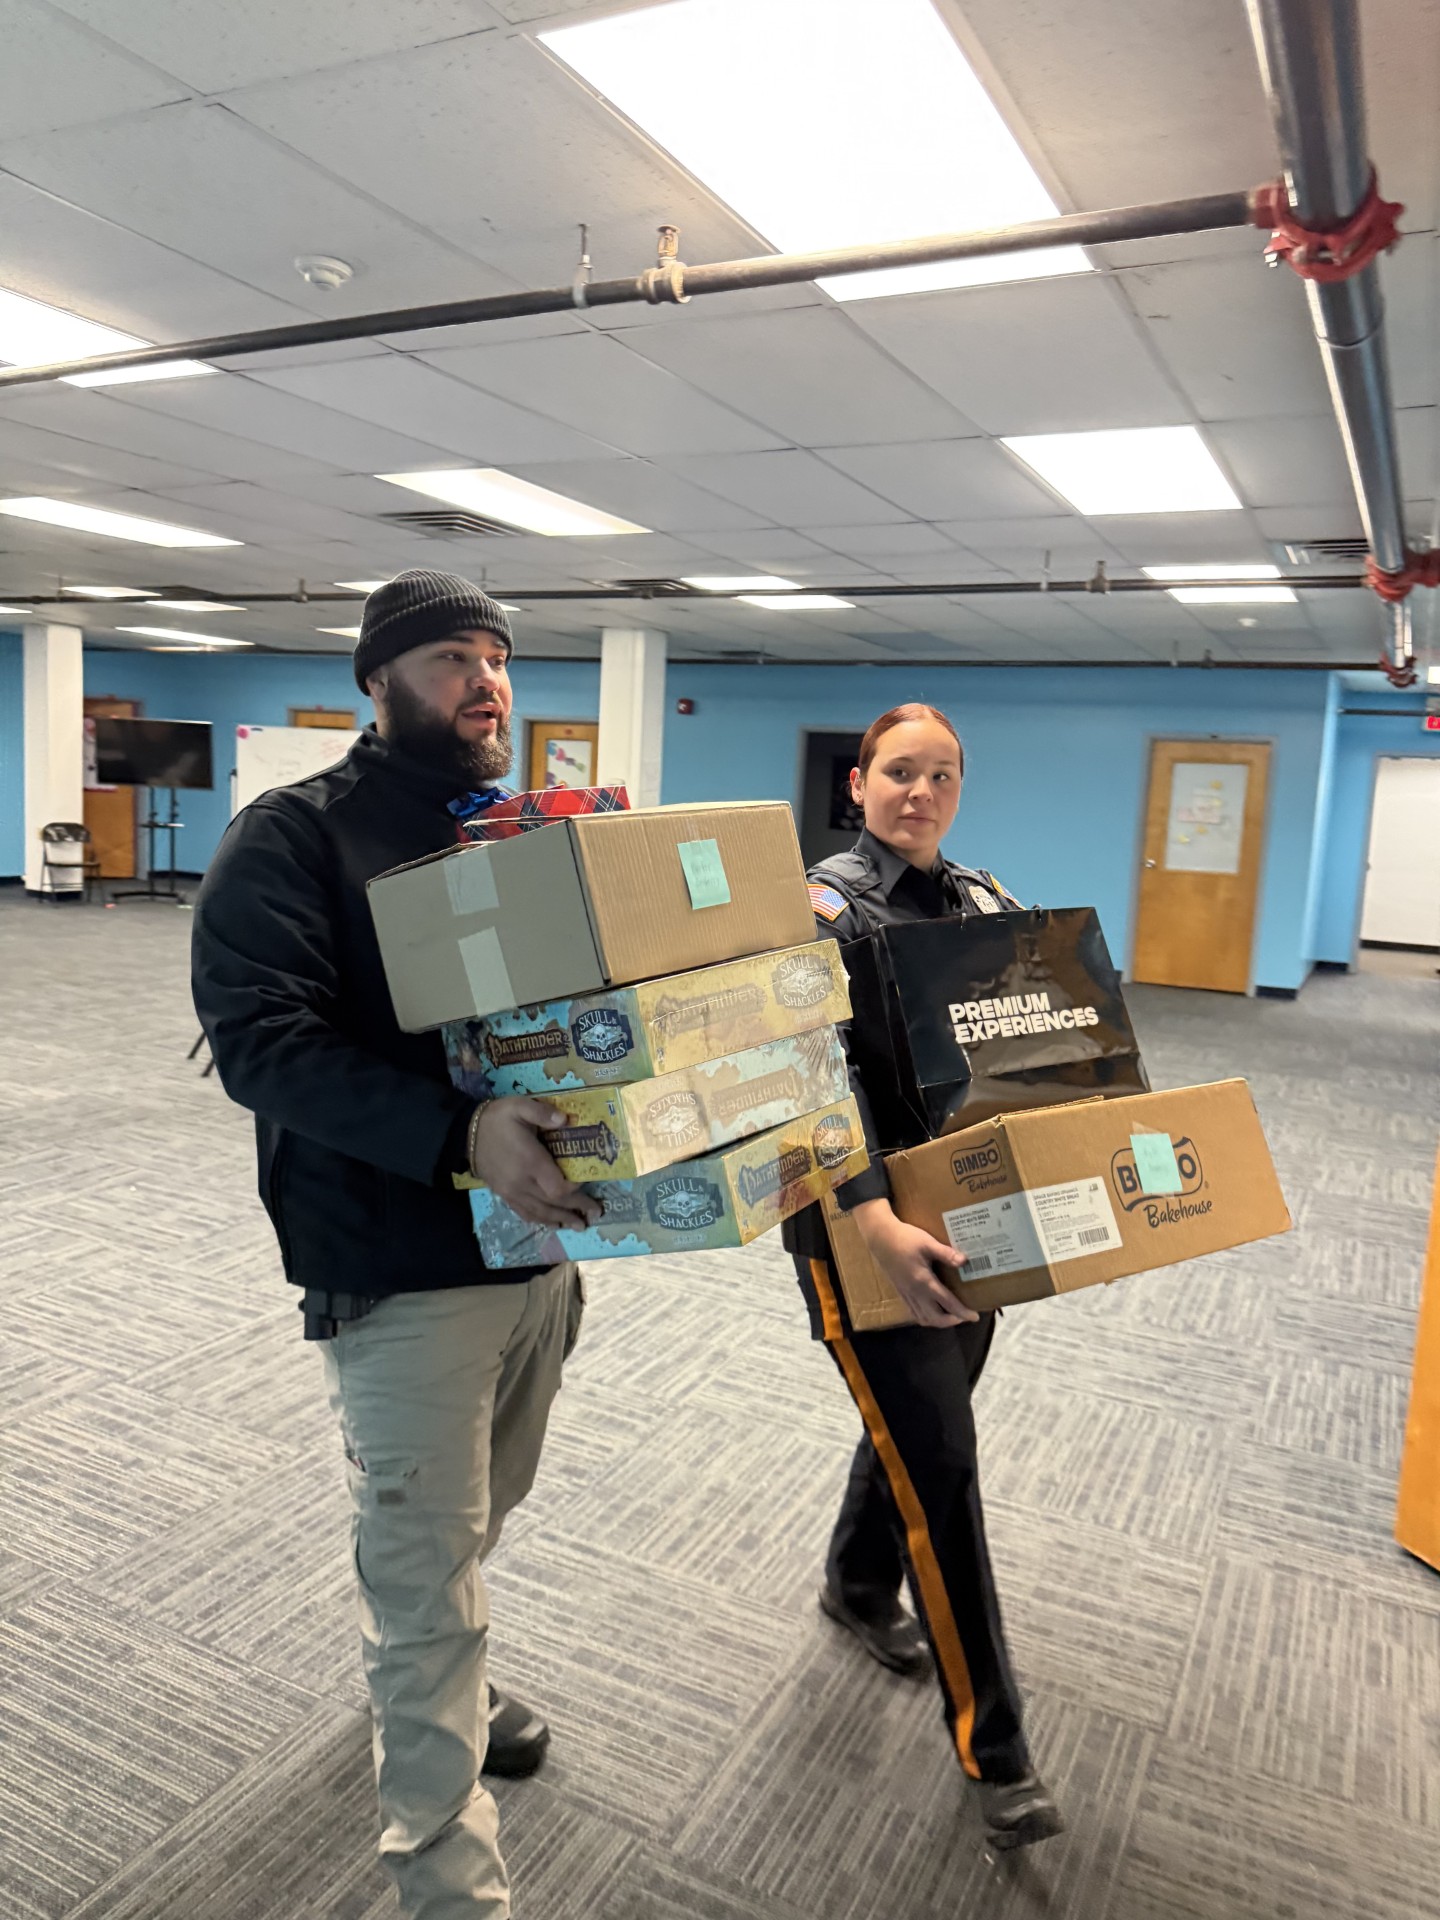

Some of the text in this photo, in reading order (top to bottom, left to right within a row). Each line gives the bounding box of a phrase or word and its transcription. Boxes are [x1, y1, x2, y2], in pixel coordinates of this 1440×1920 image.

[779, 956, 813, 977] SKULL
[783, 986, 827, 1007] SHACKLES
[948, 992, 1051, 1024] PREMIUM
[578, 1010, 611, 1032] SKULL
[953, 1006, 1099, 1044] EXPERIENCES
[488, 1031, 563, 1067] PATHFINDER
[582, 1043, 626, 1062] SHACKLES
[649, 1092, 697, 1118] SHACKLES
[720, 1070, 800, 1115] PATHFINDER
[551, 1122, 612, 1163] PATHFIN
[666, 1121, 700, 1147] SKULL
[953, 1149, 999, 1175] BIMBO
[1116, 1153, 1197, 1193] BIO
[656, 1178, 698, 1198] SKULL
[741, 1149, 806, 1207] PATHFINDER
[659, 1210, 713, 1229] SHACKLES
[1142, 1198, 1213, 1228] Bakehouse
